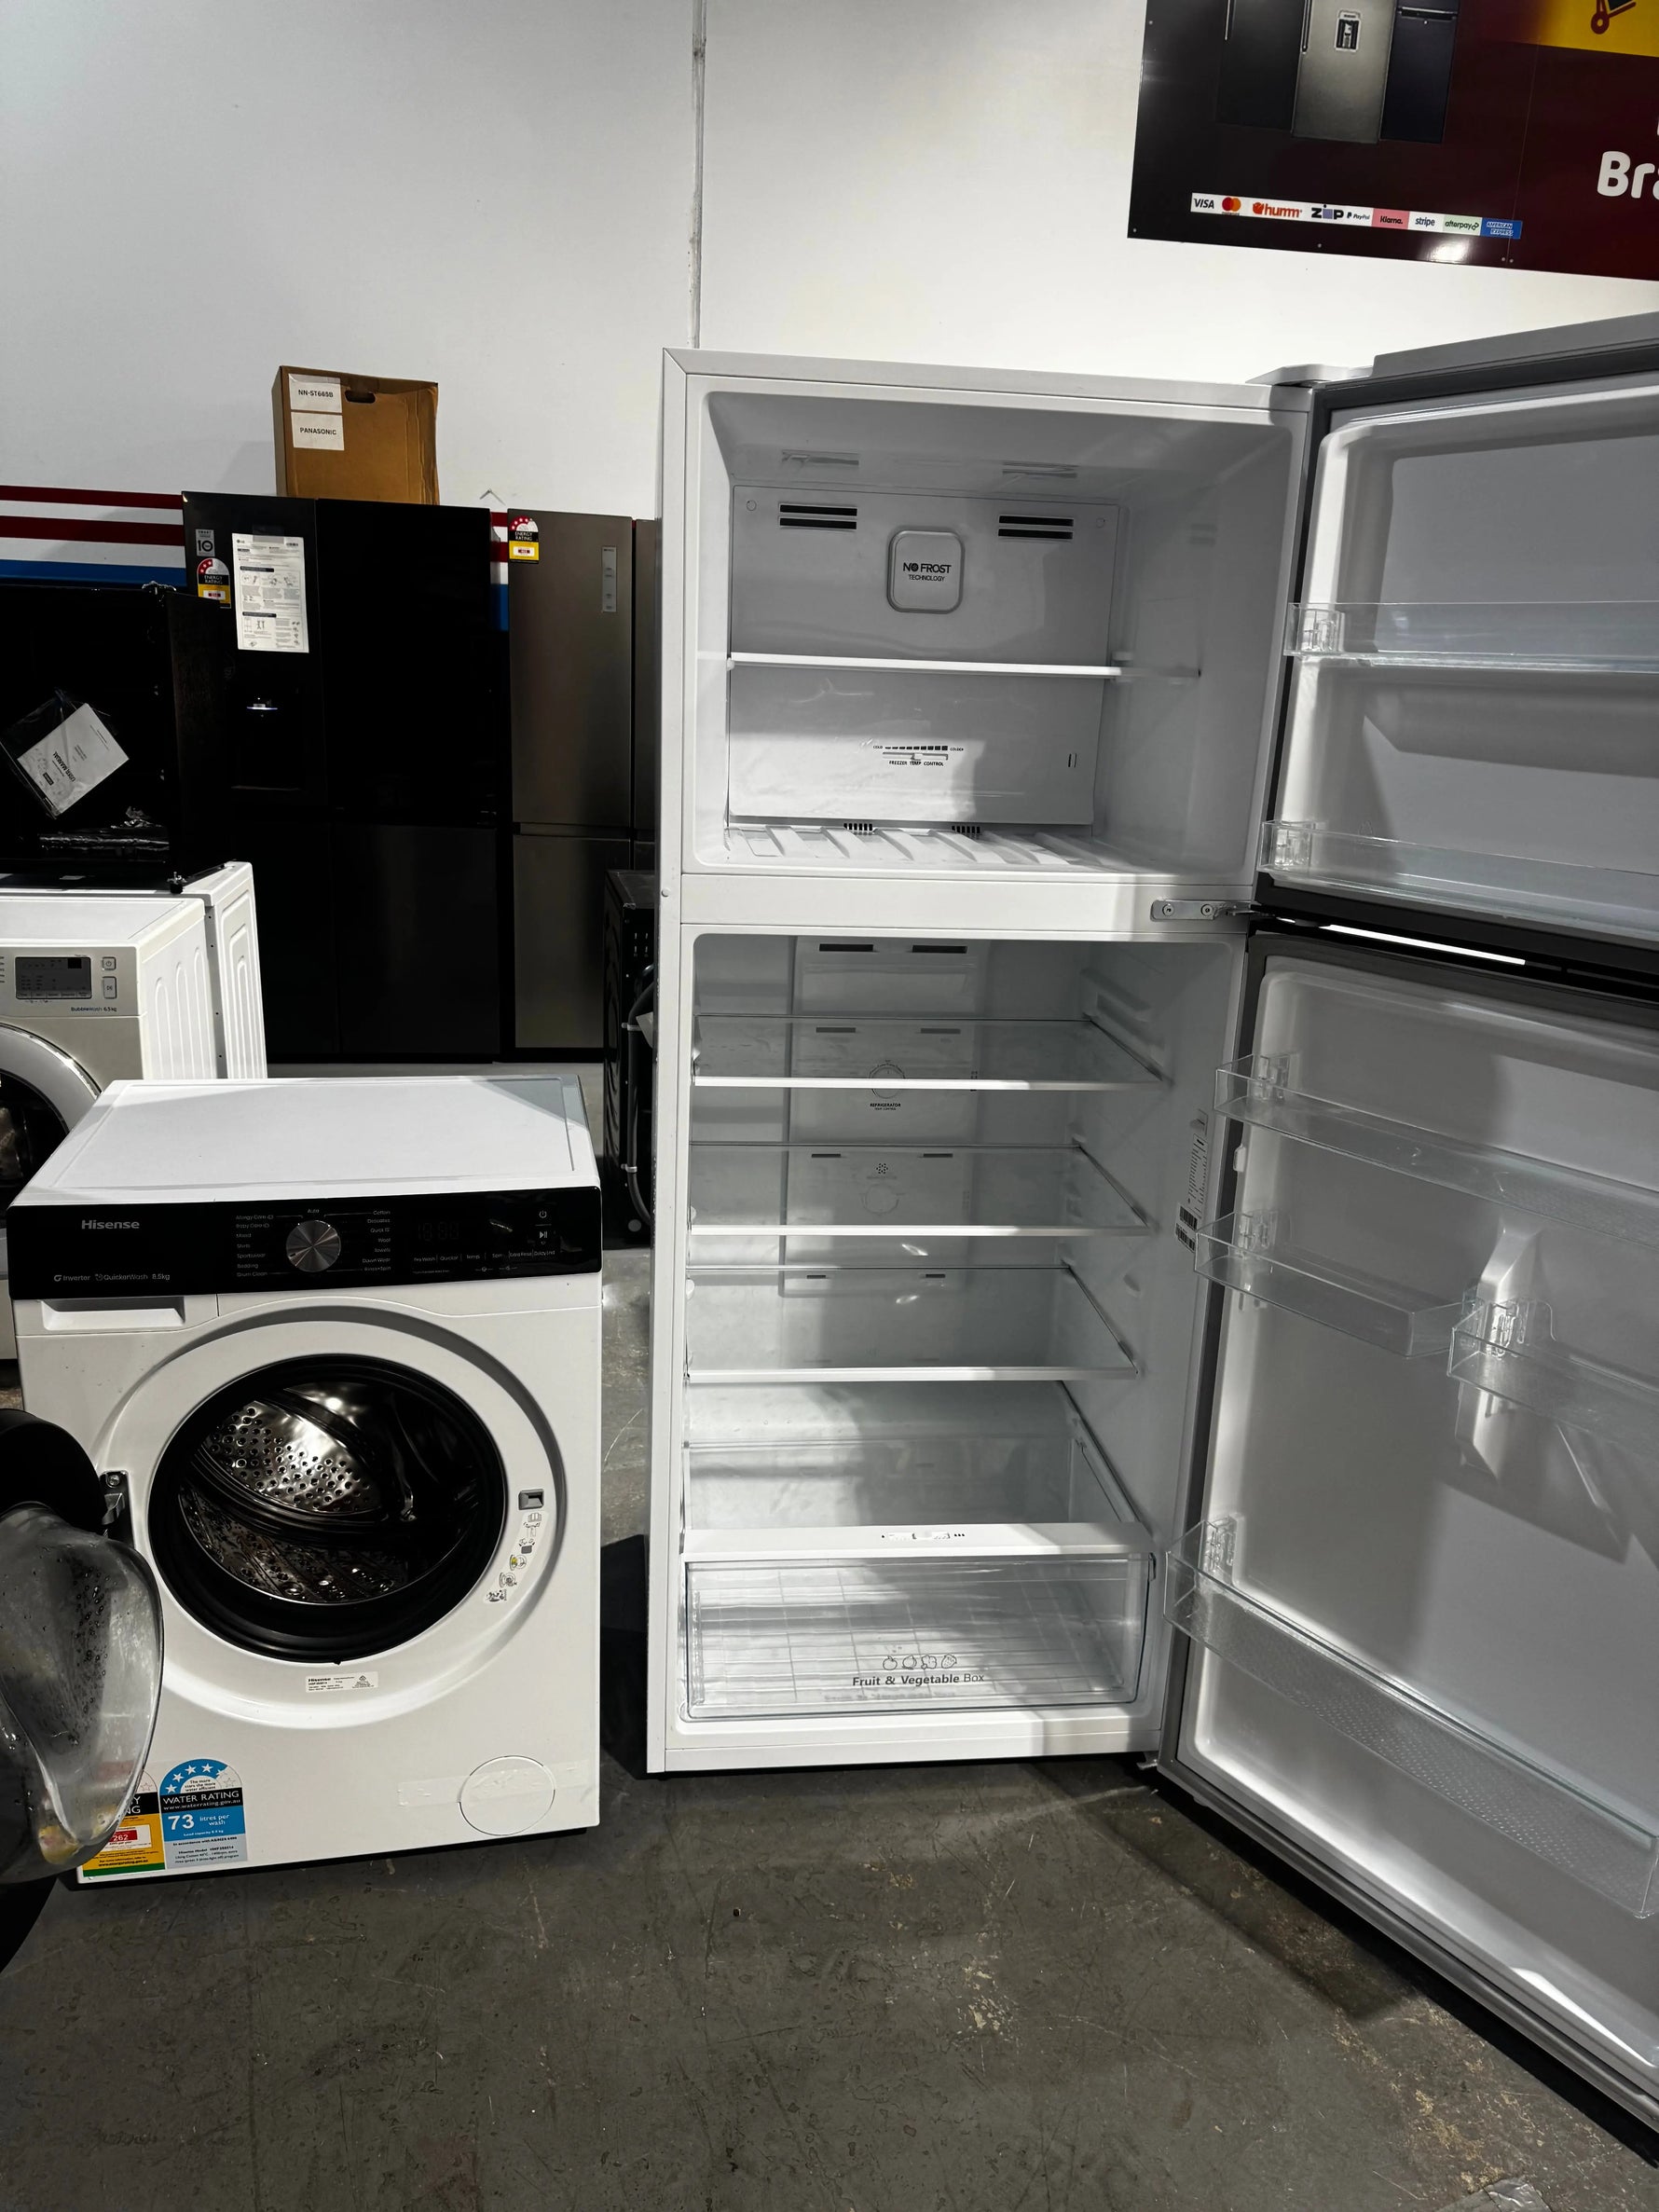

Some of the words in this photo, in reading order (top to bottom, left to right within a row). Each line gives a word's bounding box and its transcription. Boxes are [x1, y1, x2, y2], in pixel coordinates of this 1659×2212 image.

[1193, 198, 1214, 209] VISA
[1265, 203, 1300, 217] humm
[1415, 216, 1435, 227] stripe
[1445, 220, 1472, 229] afterpay
[1487, 221, 1513, 229] AMERICAN
[299, 427, 337, 435] PANASONIC
[902, 562, 919, 572] NO
[920, 563, 952, 573] FROST
[81, 1219, 140, 1230] Hisense
[852, 1676, 881, 1686] Fruit
[885, 1676, 896, 1685] &
[900, 1674, 960, 1687] Vegetable
[963, 1673, 985, 1683] Box
[162, 1795, 198, 1805] WATER
[201, 1791, 240, 1801] RATING
[163, 1799, 240, 1810] www.waterrating.gov.au
[168, 1814, 195, 1830] 73
